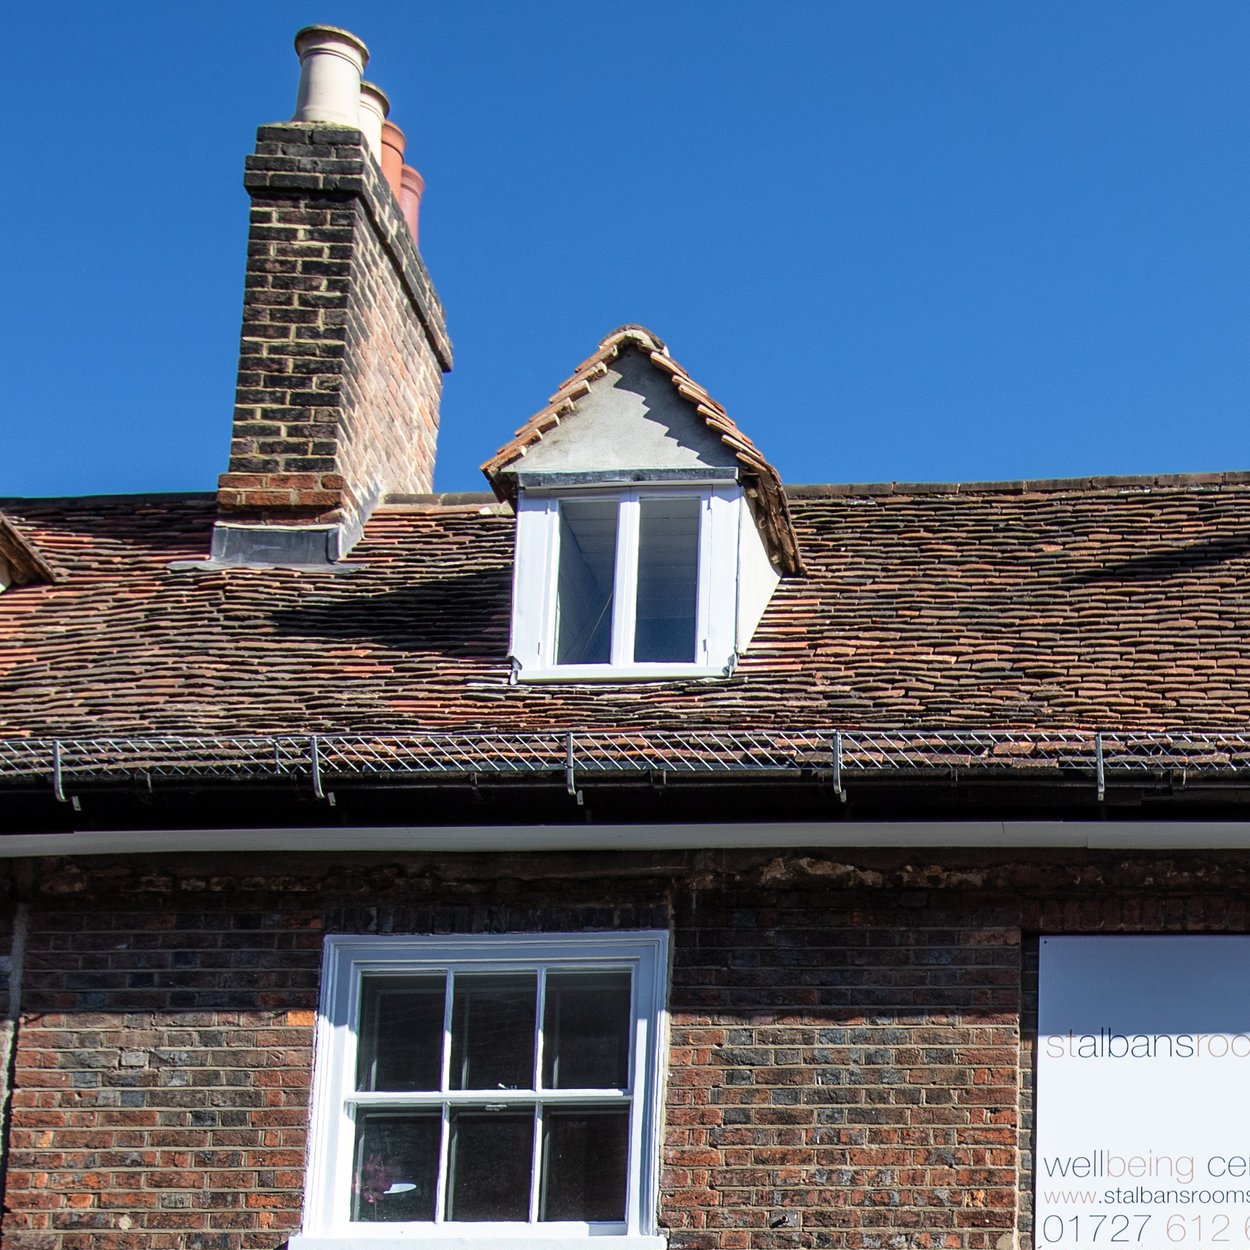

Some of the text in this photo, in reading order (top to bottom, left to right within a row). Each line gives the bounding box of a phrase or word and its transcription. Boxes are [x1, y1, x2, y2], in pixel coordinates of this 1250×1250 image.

[1043, 1149, 1195, 1184] wellbeing
[1043, 1214, 1152, 1243] 01727
[1166, 1214, 1231, 1242] 612
